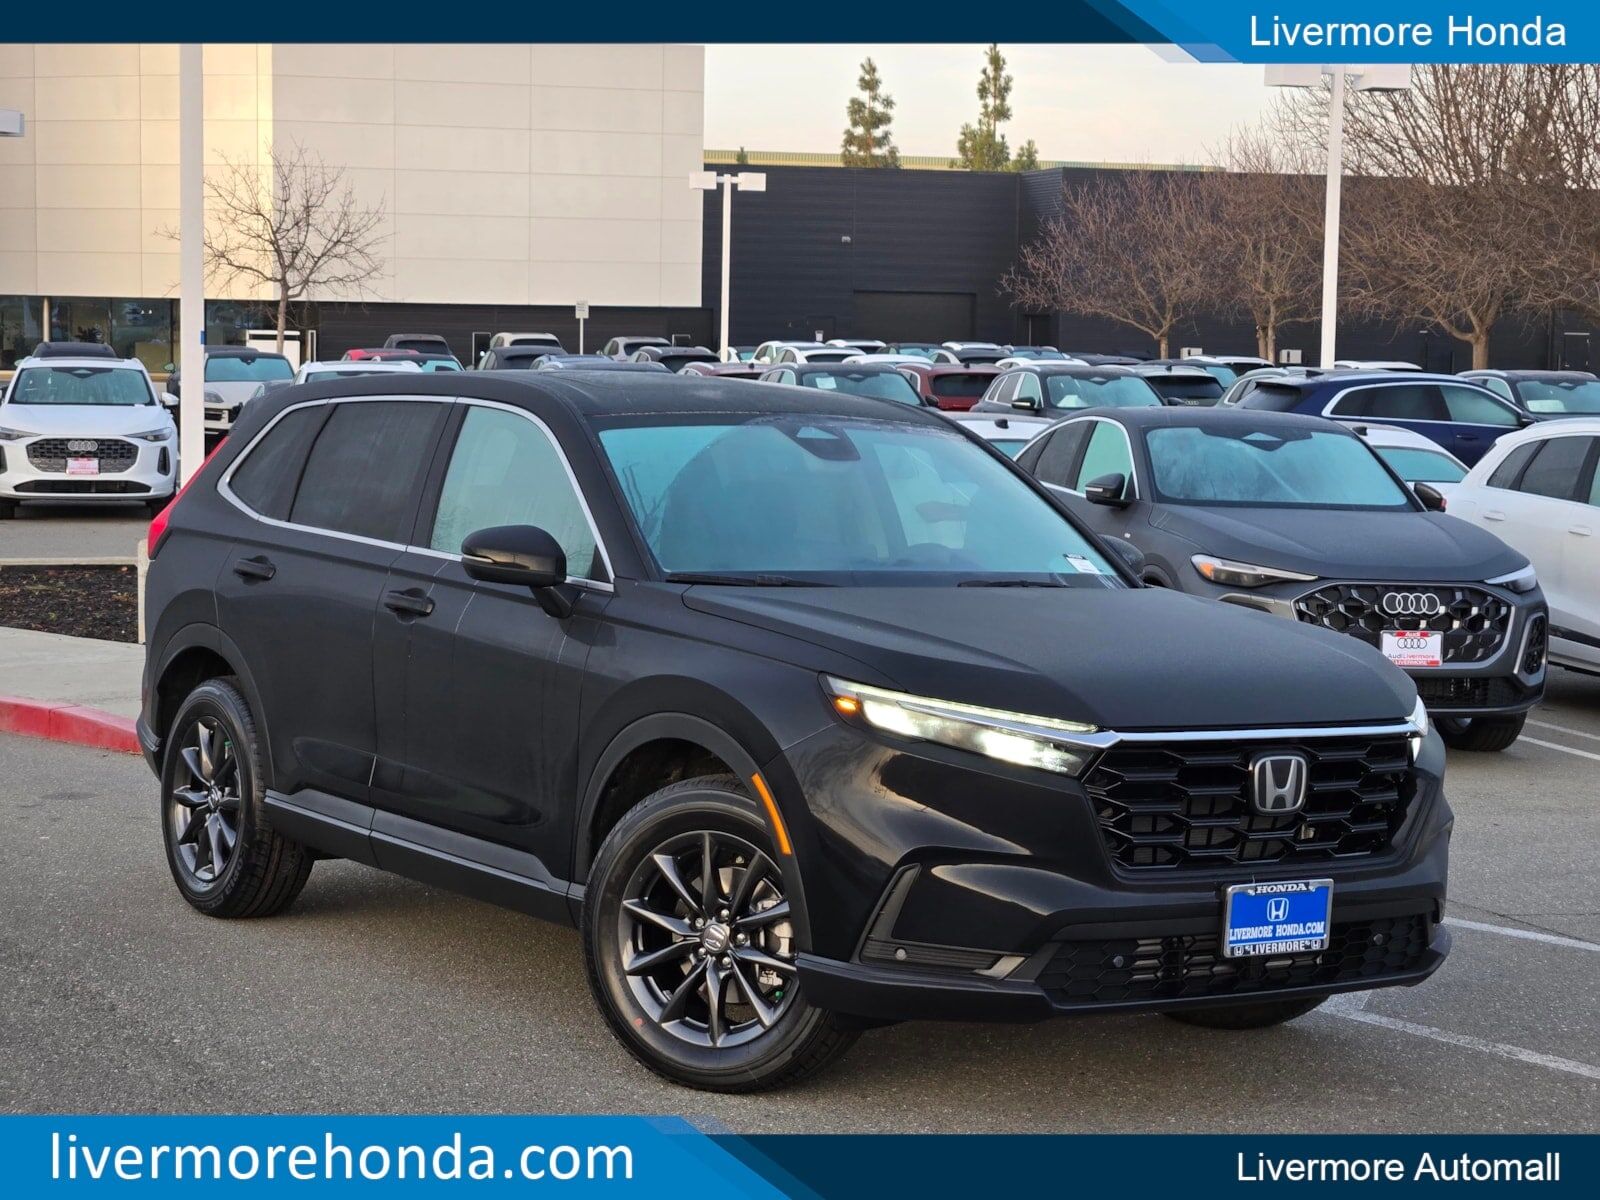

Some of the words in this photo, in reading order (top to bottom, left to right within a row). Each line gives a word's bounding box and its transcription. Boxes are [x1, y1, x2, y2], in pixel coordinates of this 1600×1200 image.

[1256, 883, 1307, 894] HONDA
[1229, 925, 1273, 941] LIVERMORE
[1275, 921, 1325, 937] HONDA.COM
[1250, 941, 1305, 955] LIVERMORE
